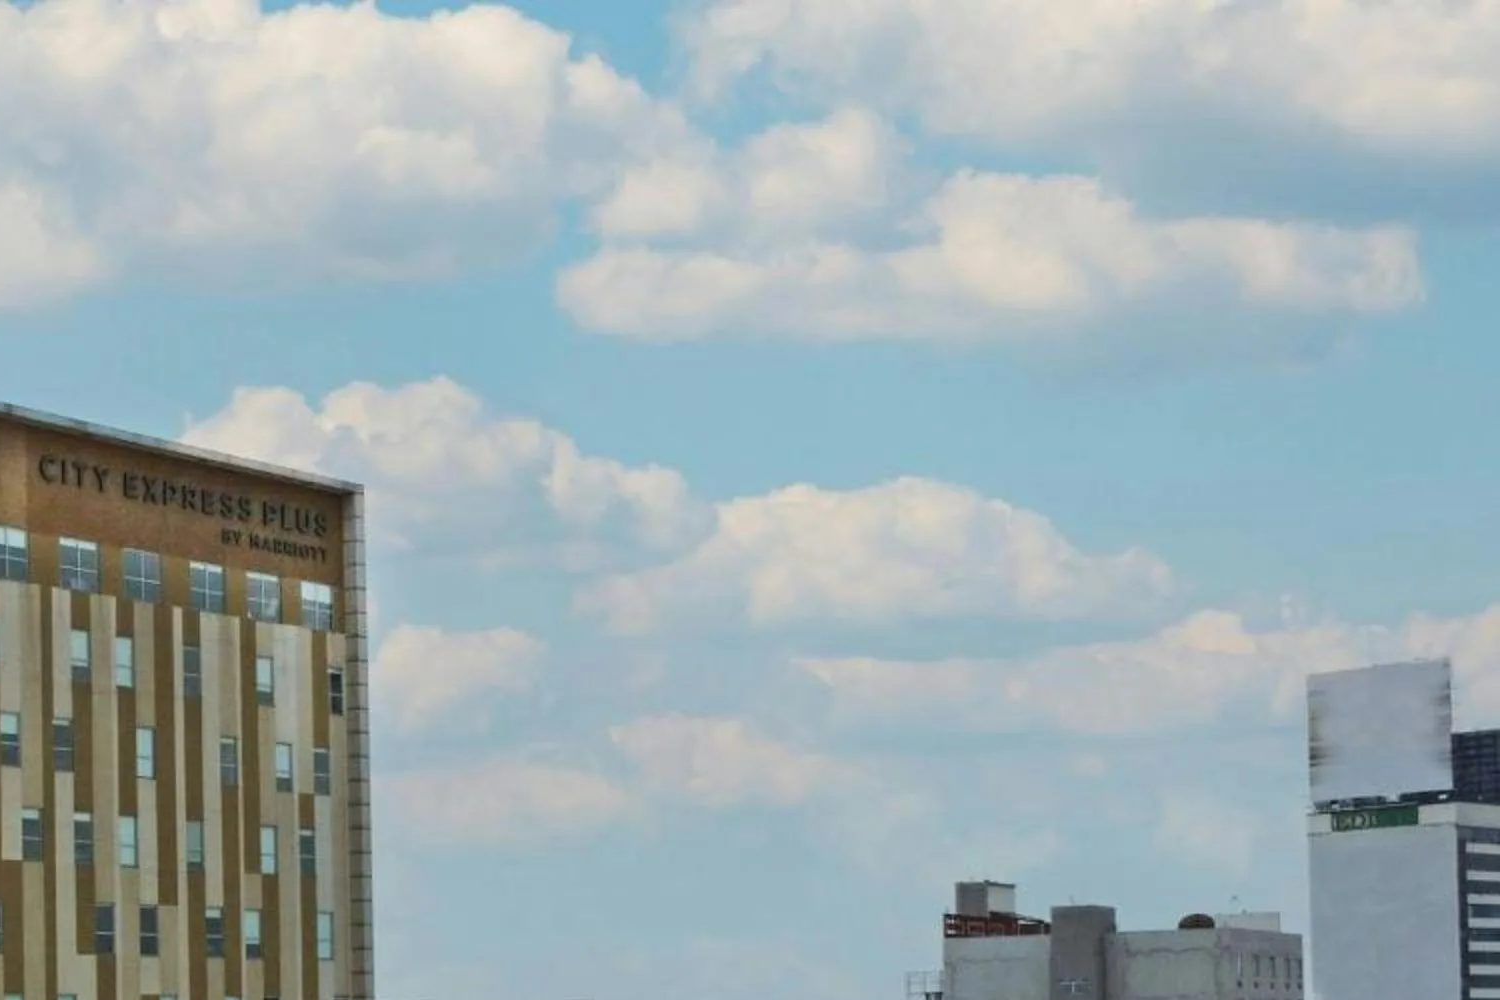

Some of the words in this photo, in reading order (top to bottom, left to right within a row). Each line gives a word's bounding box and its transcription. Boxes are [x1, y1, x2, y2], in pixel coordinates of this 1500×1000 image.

[39, 455, 108, 493] CITY
[122, 471, 251, 522] EXPRESS
[263, 501, 328, 537] PLUS
[221, 528, 241, 546] BY
